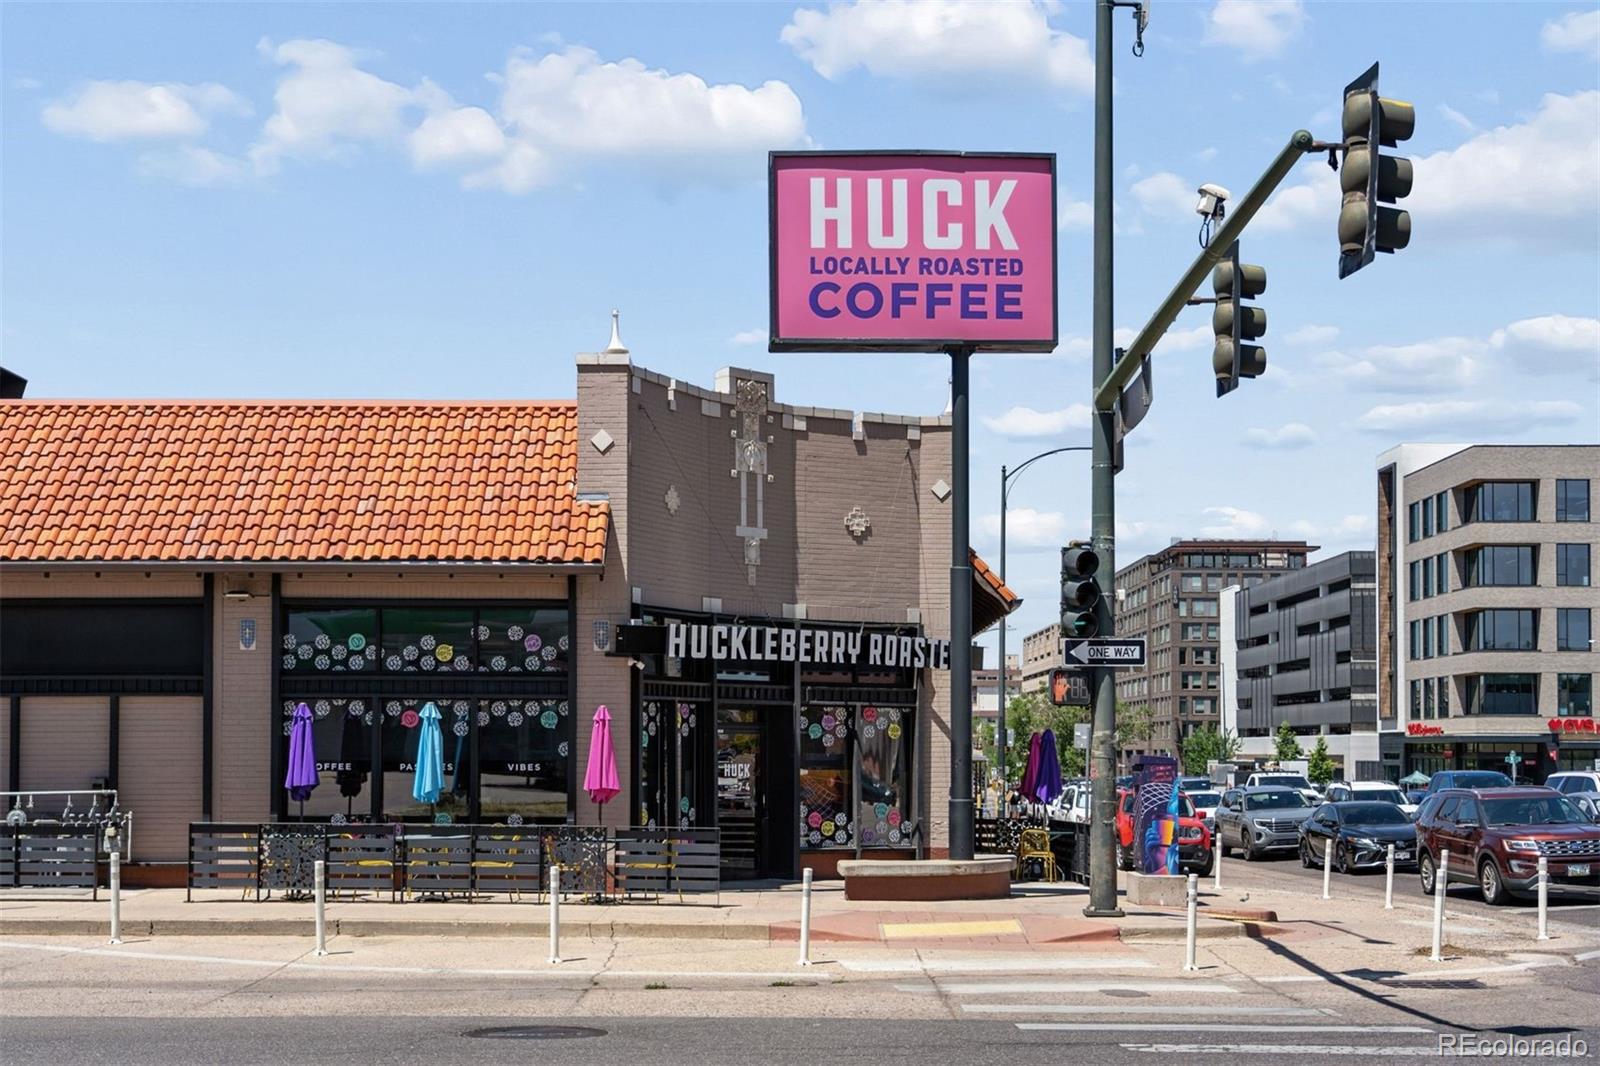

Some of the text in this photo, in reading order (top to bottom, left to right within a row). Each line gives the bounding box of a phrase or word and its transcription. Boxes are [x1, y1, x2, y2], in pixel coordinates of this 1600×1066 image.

[810, 177, 1019, 251] HUCK
[810, 256, 1023, 276] LOCALLY ROASTED
[809, 281, 1023, 320] COFFEE
[668, 624, 950, 669] HUCKLEBERRY ROASTE
[1088, 647, 1137, 658] ONE WAY
[1563, 718, 1594, 732] CVS
[316, 762, 351, 771] OFFEE
[508, 763, 541, 772] VIBES
[724, 763, 750, 777] HUCK
